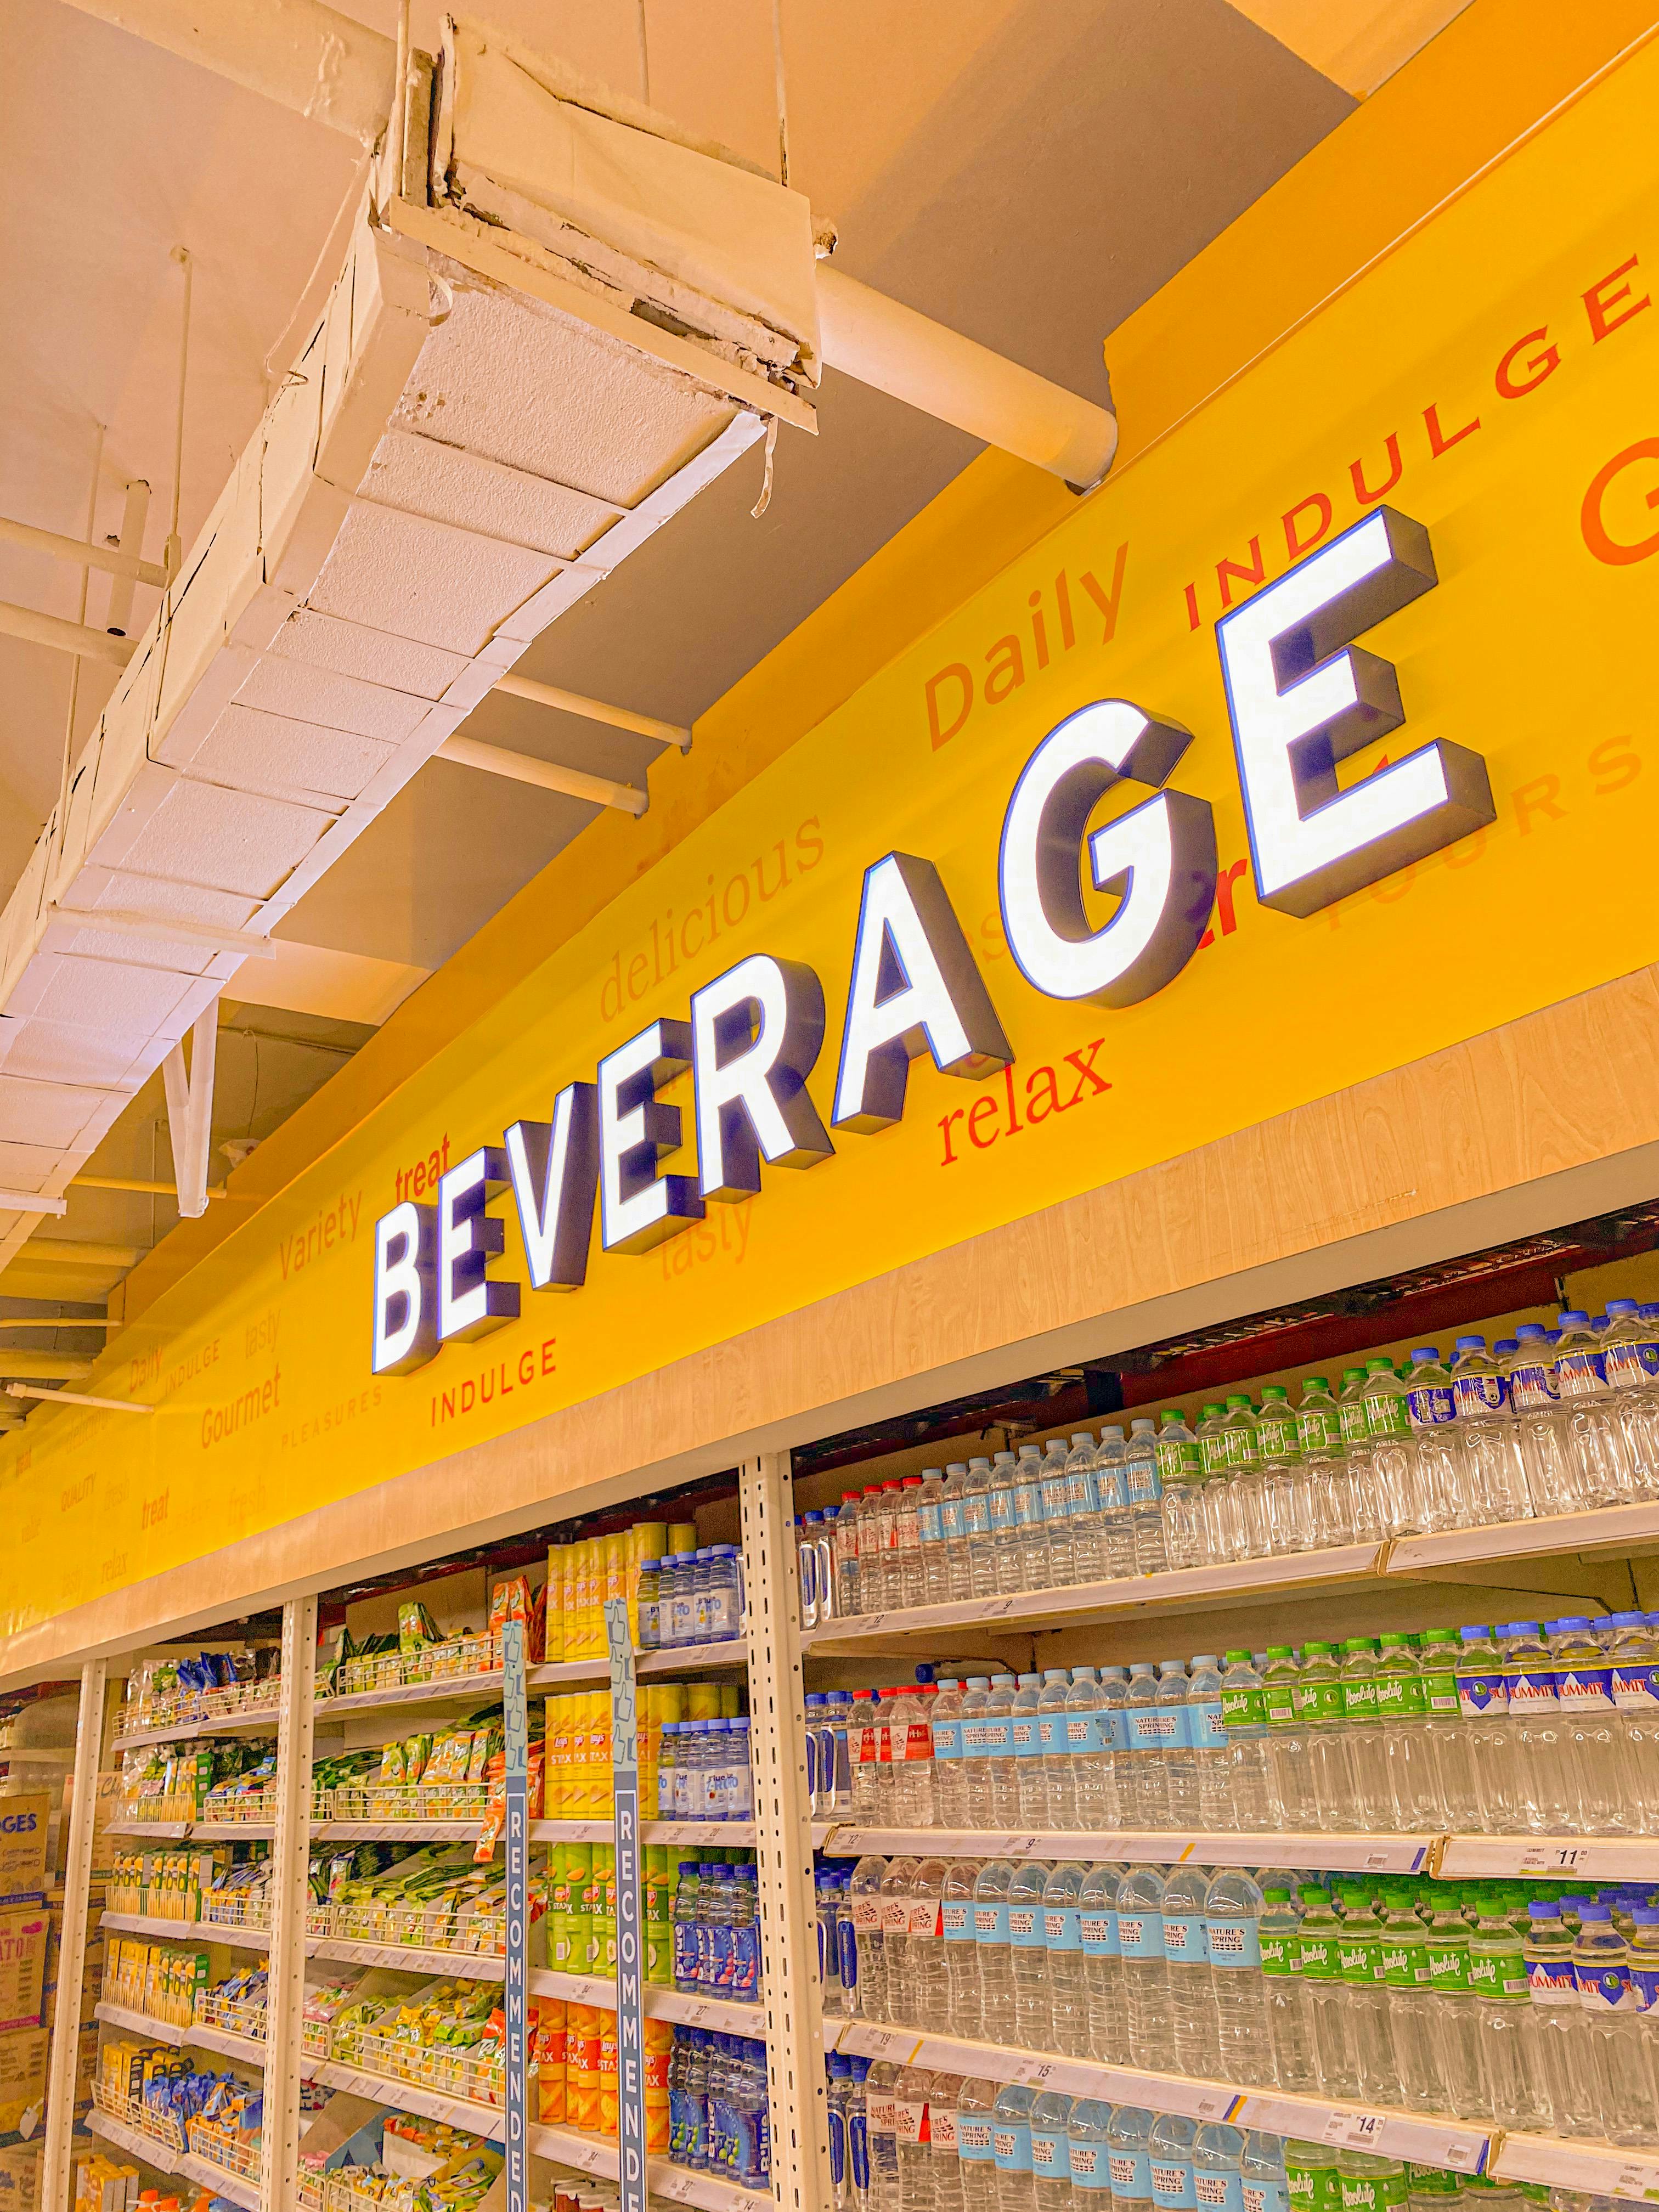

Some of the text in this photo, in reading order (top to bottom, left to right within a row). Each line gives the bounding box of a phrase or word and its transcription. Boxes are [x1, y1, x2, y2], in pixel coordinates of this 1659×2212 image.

[1183, 253, 1652, 633] INDULGE
[924, 540, 1128, 752] Daily
[600, 815, 825, 1023] delicious
[371, 505, 1497, 1377] BEVERAGE
[937, 1037, 1113, 1167] relax
[395, 1131, 451, 1205] treat
[279, 1189, 362, 1281] Variety
[245, 1308, 281, 1359] tasty
[128, 1345, 163, 1394] Daily
[165, 1338, 221, 1396] INDULGE
[431, 1336, 556, 1427] INDULGE
[201, 1362, 281, 1449] Gourmet
[281, 1384, 382, 1453] PLEASURES
[61, 1472, 97, 1513] QUALITY
[142, 1485, 171, 1531] treat
[228, 1476, 267, 1527] fresh
[101, 1549, 128, 1584] relax
[873, 1615, 884, 1623] 12
[1003, 1600, 1013, 1610] 9
[1346, 1683, 1375, 1710] Absolute
[1510, 1684, 1554, 1699] SUMMIT
[1559, 1681, 1604, 1696] SUMMIT
[551, 1753, 572, 1765] STAX
[0, 1813, 37, 1833] GES
[848, 1834, 859, 1844] 12
[1025, 1838, 1036, 1849] 9
[1430, 1952, 1461, 1980] Absolute
[510, 1810, 522, 2212] RECOMMENDED
[620, 1810, 641, 2212] RECOMMENDE
[697, 2005, 707, 2015] 27
[880, 2032, 891, 2045] 19
[1037, 2064, 1052, 2078] 15
[1360, 2117, 1376, 2134] 14
[1071, 2150, 1097, 2158] ATURE'S
